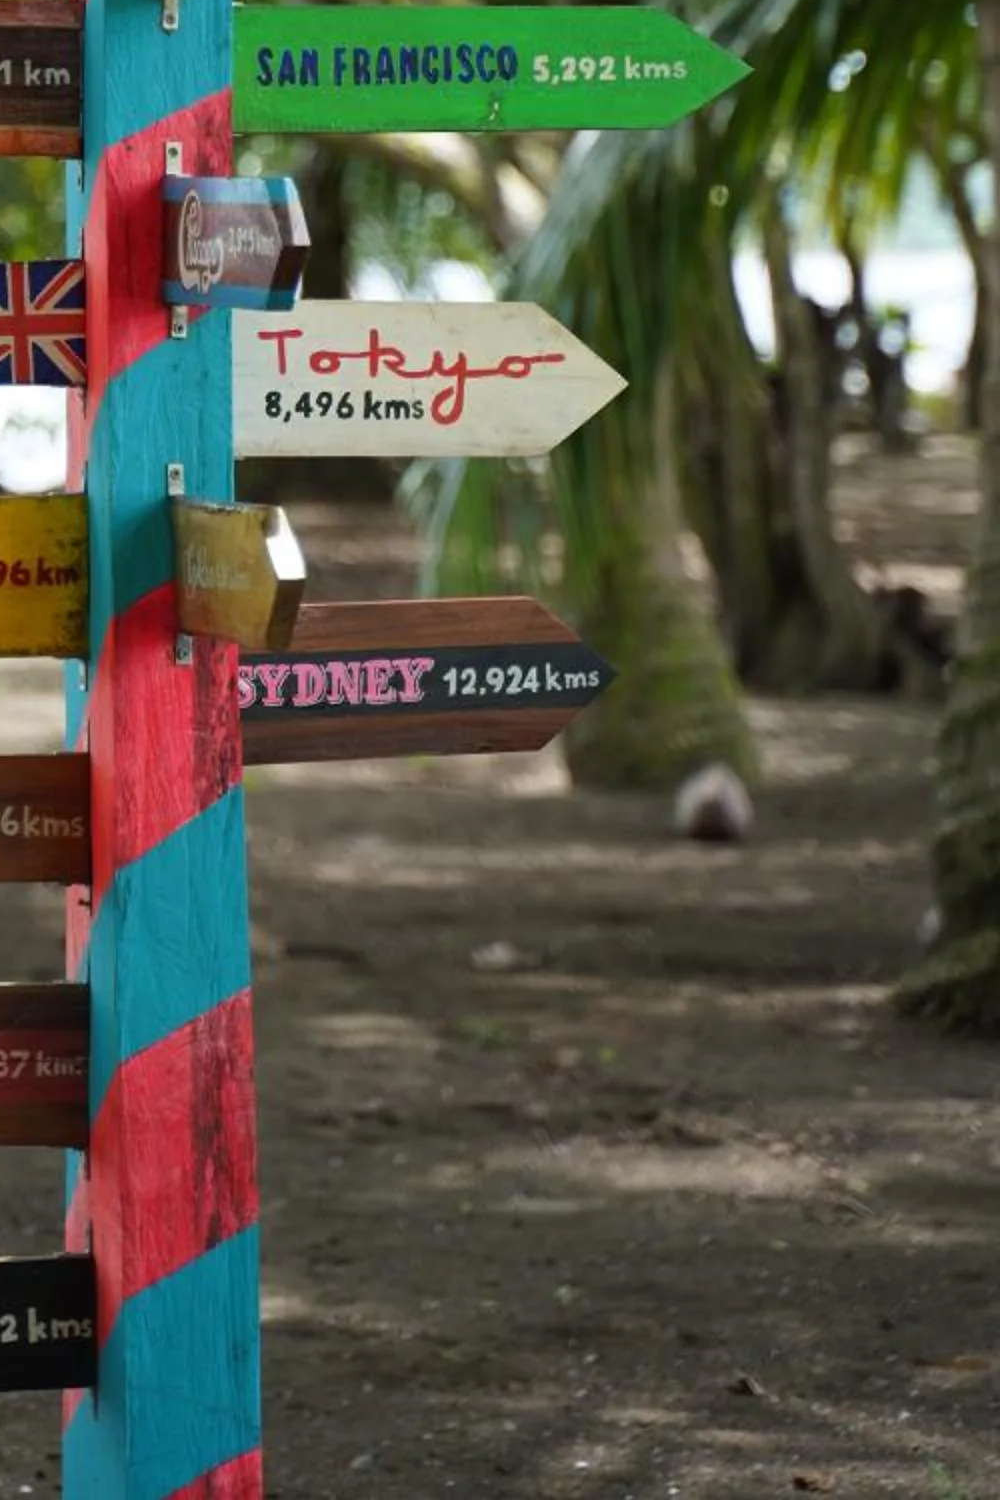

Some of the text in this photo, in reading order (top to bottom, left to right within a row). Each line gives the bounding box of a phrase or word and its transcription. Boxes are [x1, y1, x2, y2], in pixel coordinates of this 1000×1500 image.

[24, 60, 71, 86] km
[256, 44, 688, 87] SAN FRANCISCO 5,292 kms
[256, 328, 566, 426] Tokyo
[264, 390, 425, 423] 8,496 kms
[237, 657, 435, 710] SYDNEY
[545, 663, 601, 692] kms
[23, 805, 87, 837] kms
[26, 1307, 92, 1344] kms
